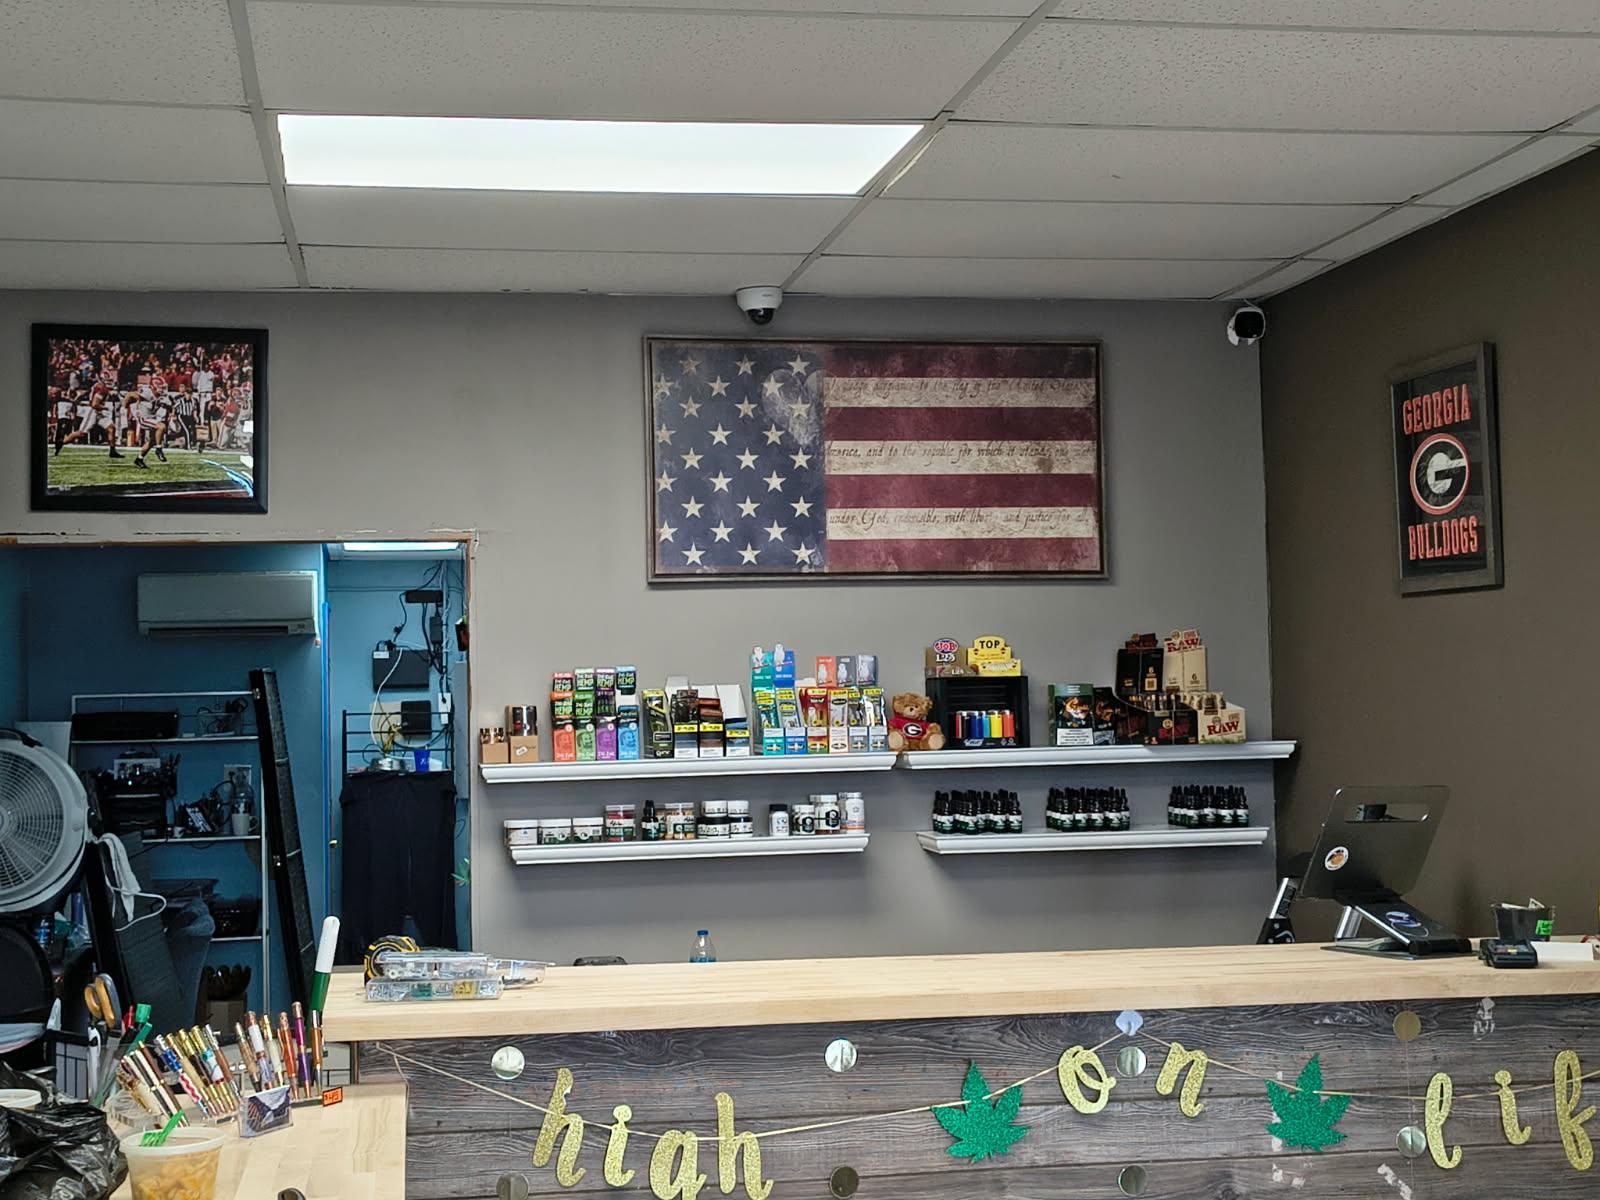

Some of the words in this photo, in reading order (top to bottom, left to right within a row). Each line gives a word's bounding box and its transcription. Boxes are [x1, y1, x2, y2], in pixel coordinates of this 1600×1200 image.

[1403, 384, 1471, 435] GEORGIA
[1408, 516, 1478, 560] BULLDOGS
[979, 640, 1001, 649] TOP
[1167, 638, 1200, 653] RAW
[1207, 720, 1239, 736] RAW
[531, 1067, 775, 1200] high
[1057, 1042, 1209, 1118] on
